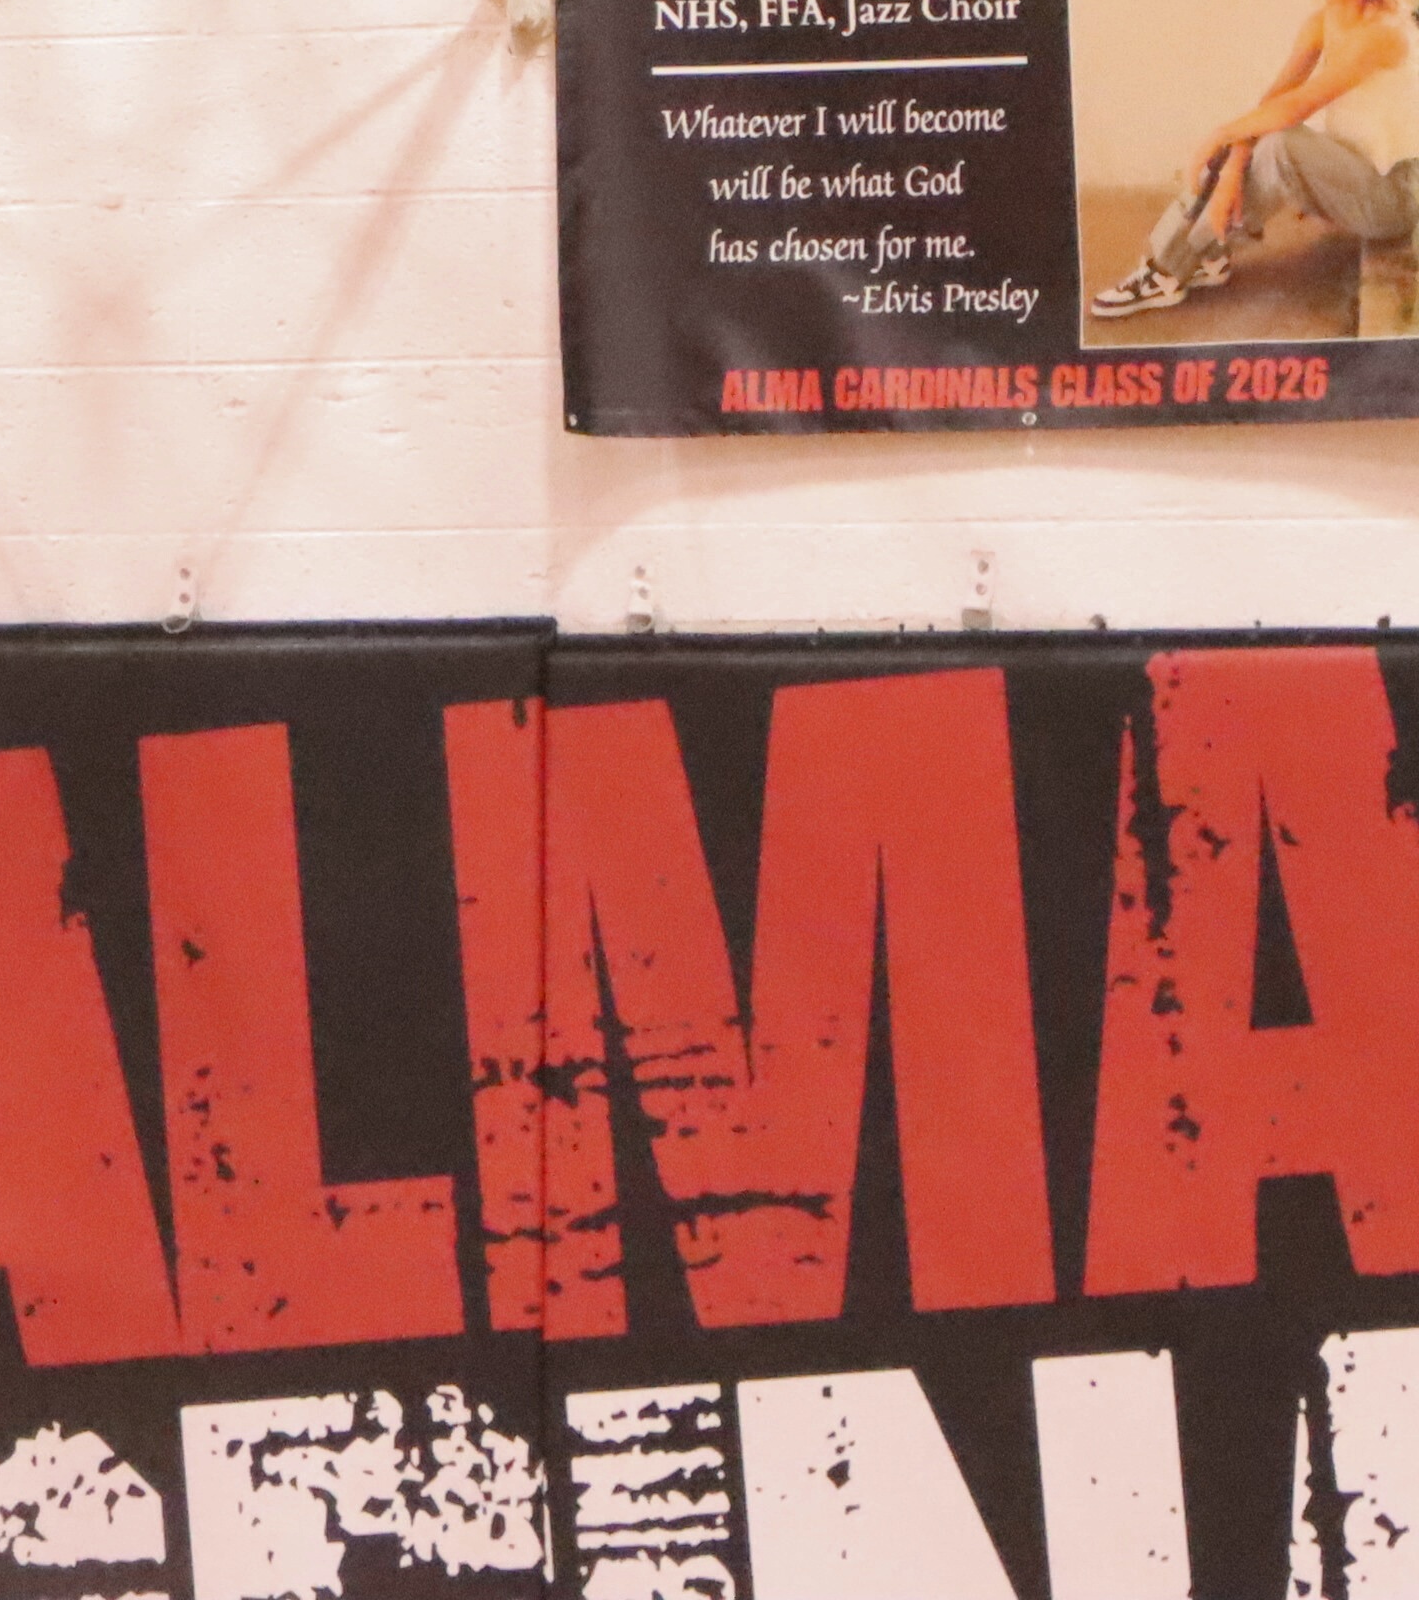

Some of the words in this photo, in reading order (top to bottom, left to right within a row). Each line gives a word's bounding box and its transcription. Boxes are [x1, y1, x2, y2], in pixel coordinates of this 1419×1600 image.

[655, 0, 747, 32] NHS,
[662, 105, 806, 139] Whatever
[817, 107, 826, 135] I
[838, 99, 896, 134] will
[905, 99, 1006, 133] become
[710, 166, 773, 200] will
[781, 165, 812, 199] be
[821, 163, 895, 198] what
[905, 160, 964, 196] God
[710, 229, 758, 263] has
[769, 228, 867, 262] chosen
[870, 225, 916, 274] for
[925, 236, 974, 258] me.
[944, 278, 1039, 323] Presley
[723, 370, 823, 410] ALMA
[835, 366, 1037, 409] CARDINALS
[1053, 364, 1162, 404] CLASS
[1174, 361, 1215, 402] OF
[1229, 358, 1328, 399] 2026
